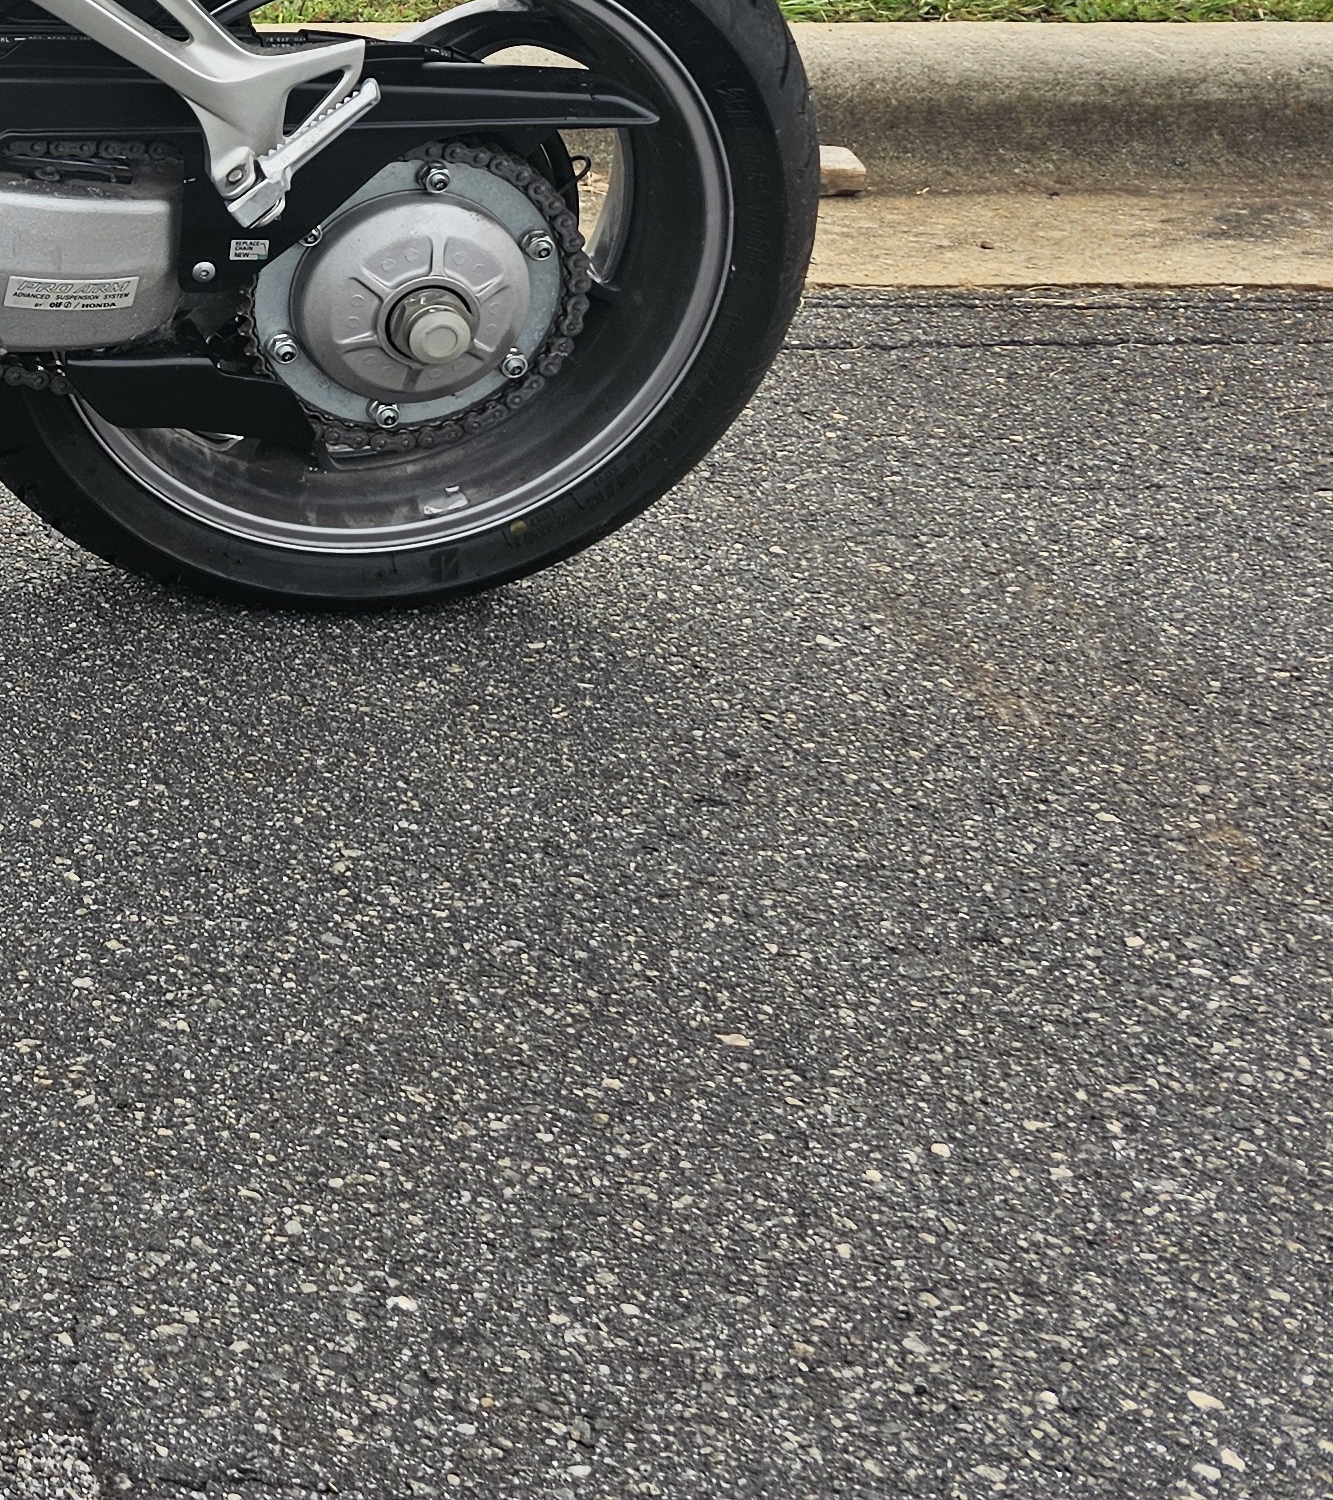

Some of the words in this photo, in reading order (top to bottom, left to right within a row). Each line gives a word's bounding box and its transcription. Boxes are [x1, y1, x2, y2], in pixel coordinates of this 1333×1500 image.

[17, 281, 73, 293] PRO
[73, 281, 131, 293] ARM
[13, 292, 50, 300] ADVANCED
[103, 292, 130, 300] SYSTEM
